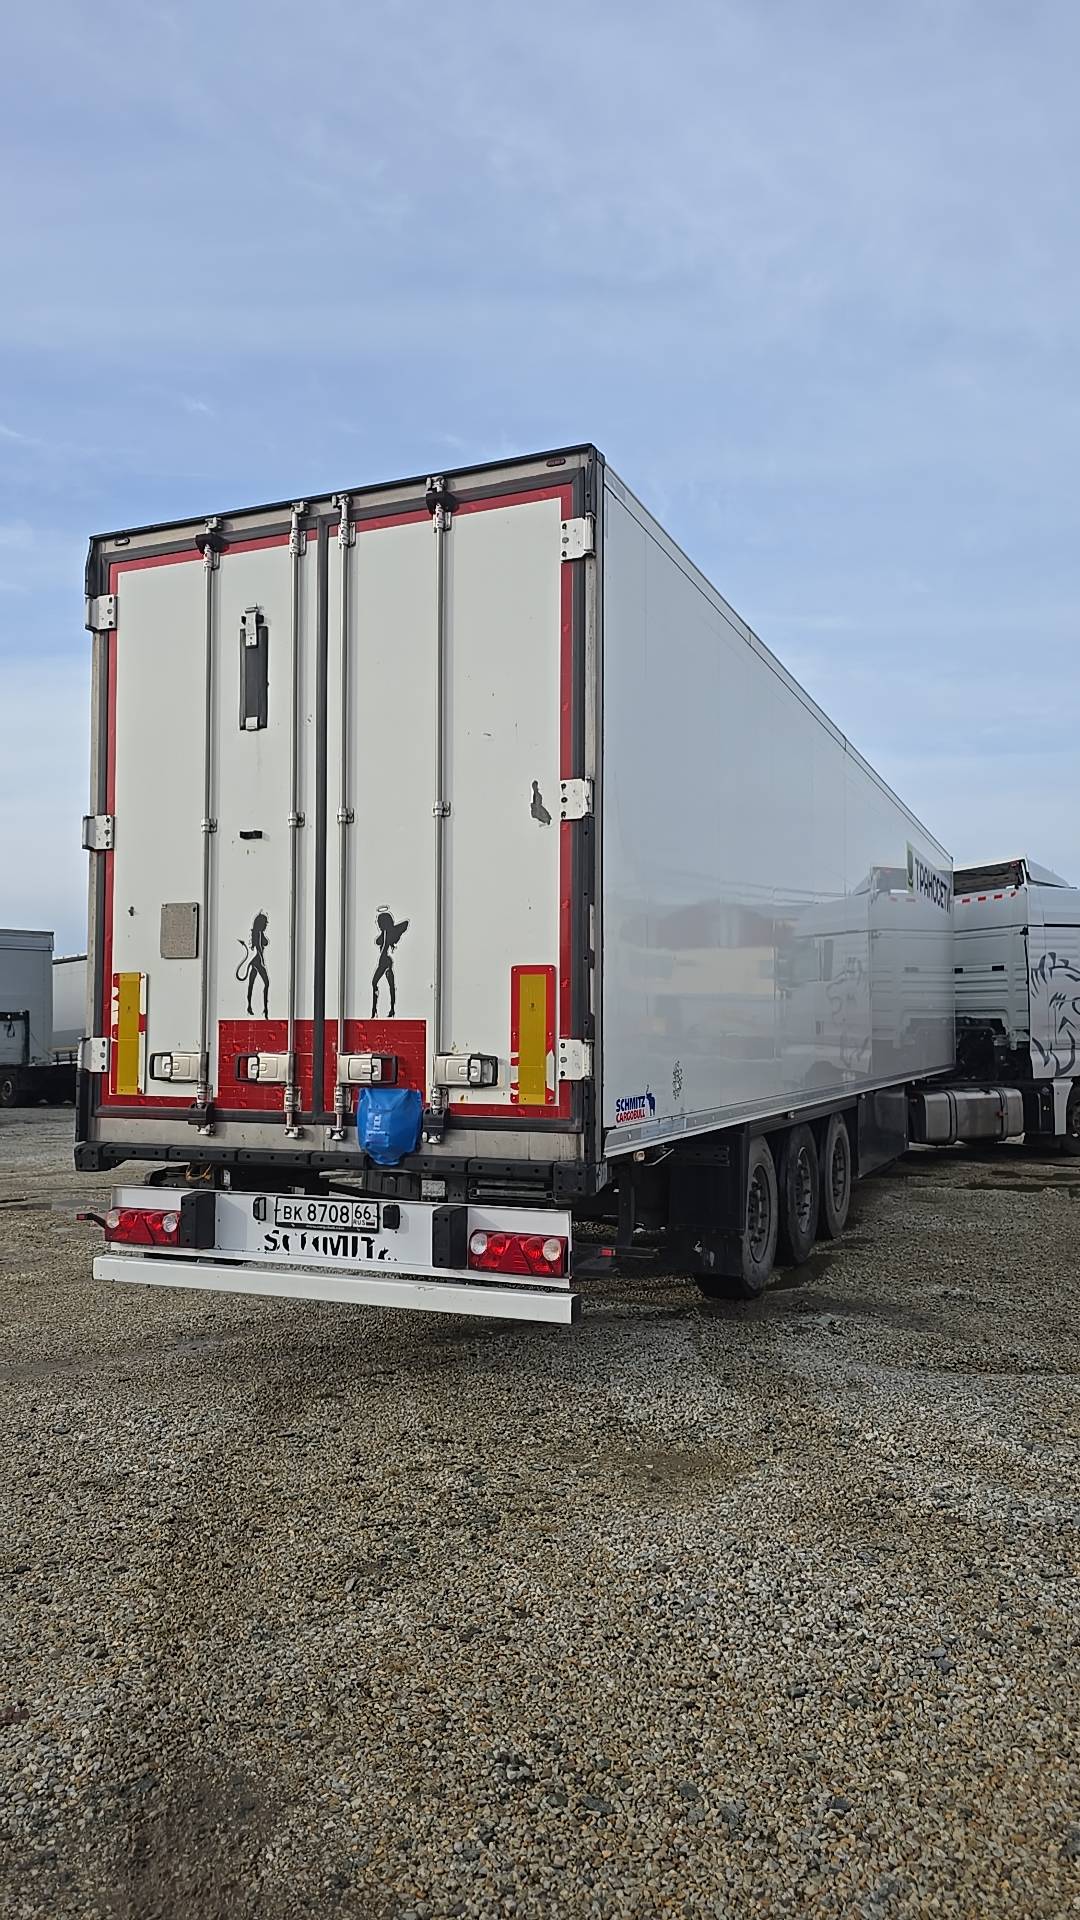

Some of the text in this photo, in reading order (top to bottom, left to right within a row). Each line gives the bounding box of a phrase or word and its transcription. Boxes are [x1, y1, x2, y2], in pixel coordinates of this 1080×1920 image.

[616, 1095, 646, 1112] SCHMITZ
[616, 1109, 646, 1123] CARGOBULL
[307, 1203, 350, 1223] 8708
[354, 1204, 372, 1220] 66
